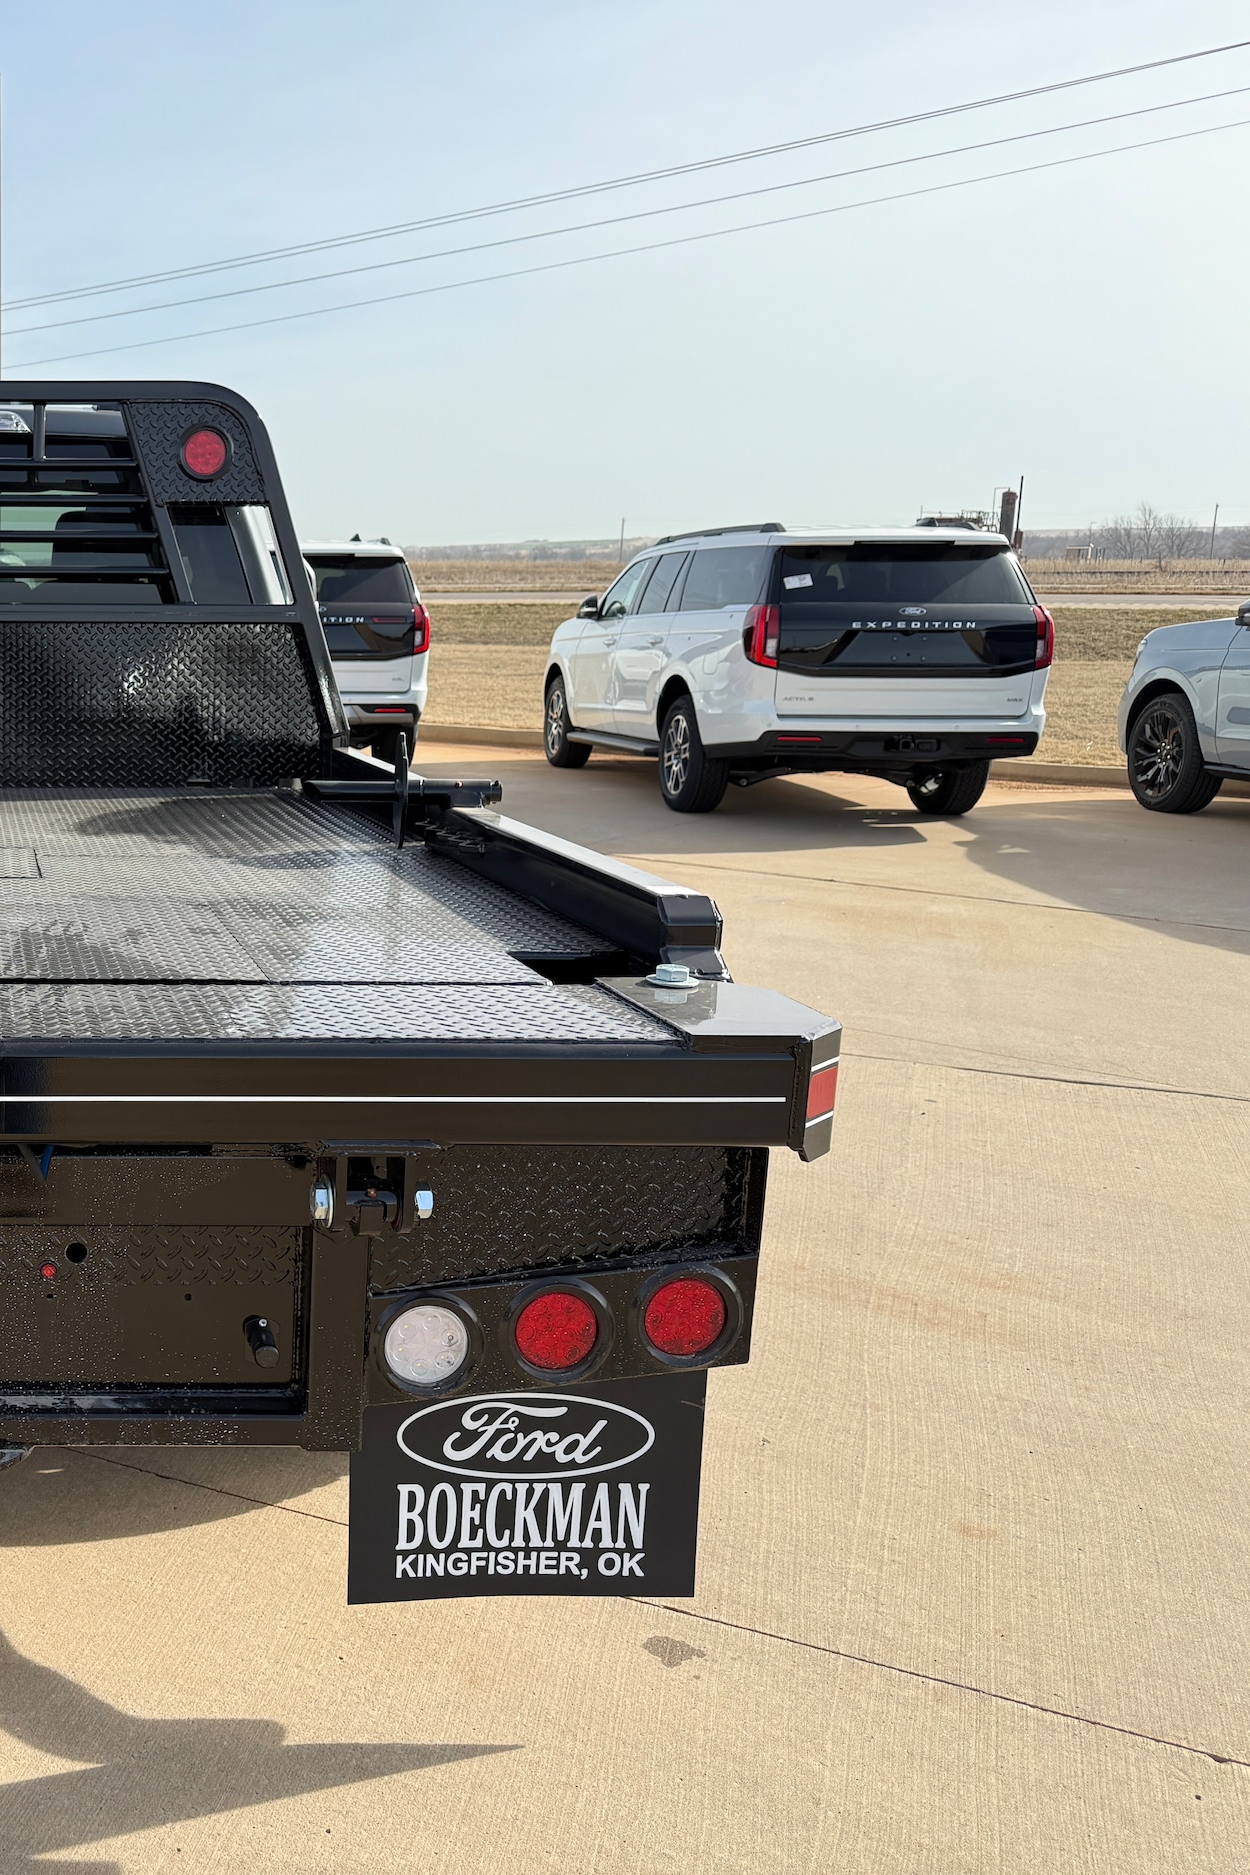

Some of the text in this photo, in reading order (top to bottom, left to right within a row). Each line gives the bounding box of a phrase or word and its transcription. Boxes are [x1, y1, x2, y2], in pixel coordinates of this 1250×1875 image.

[851, 621, 976, 629] EXPEDITION
[443, 1401, 608, 1464] Ford
[395, 1481, 651, 1551] BOECKMAN
[395, 1551, 646, 1581] KINGFISHER, OK
